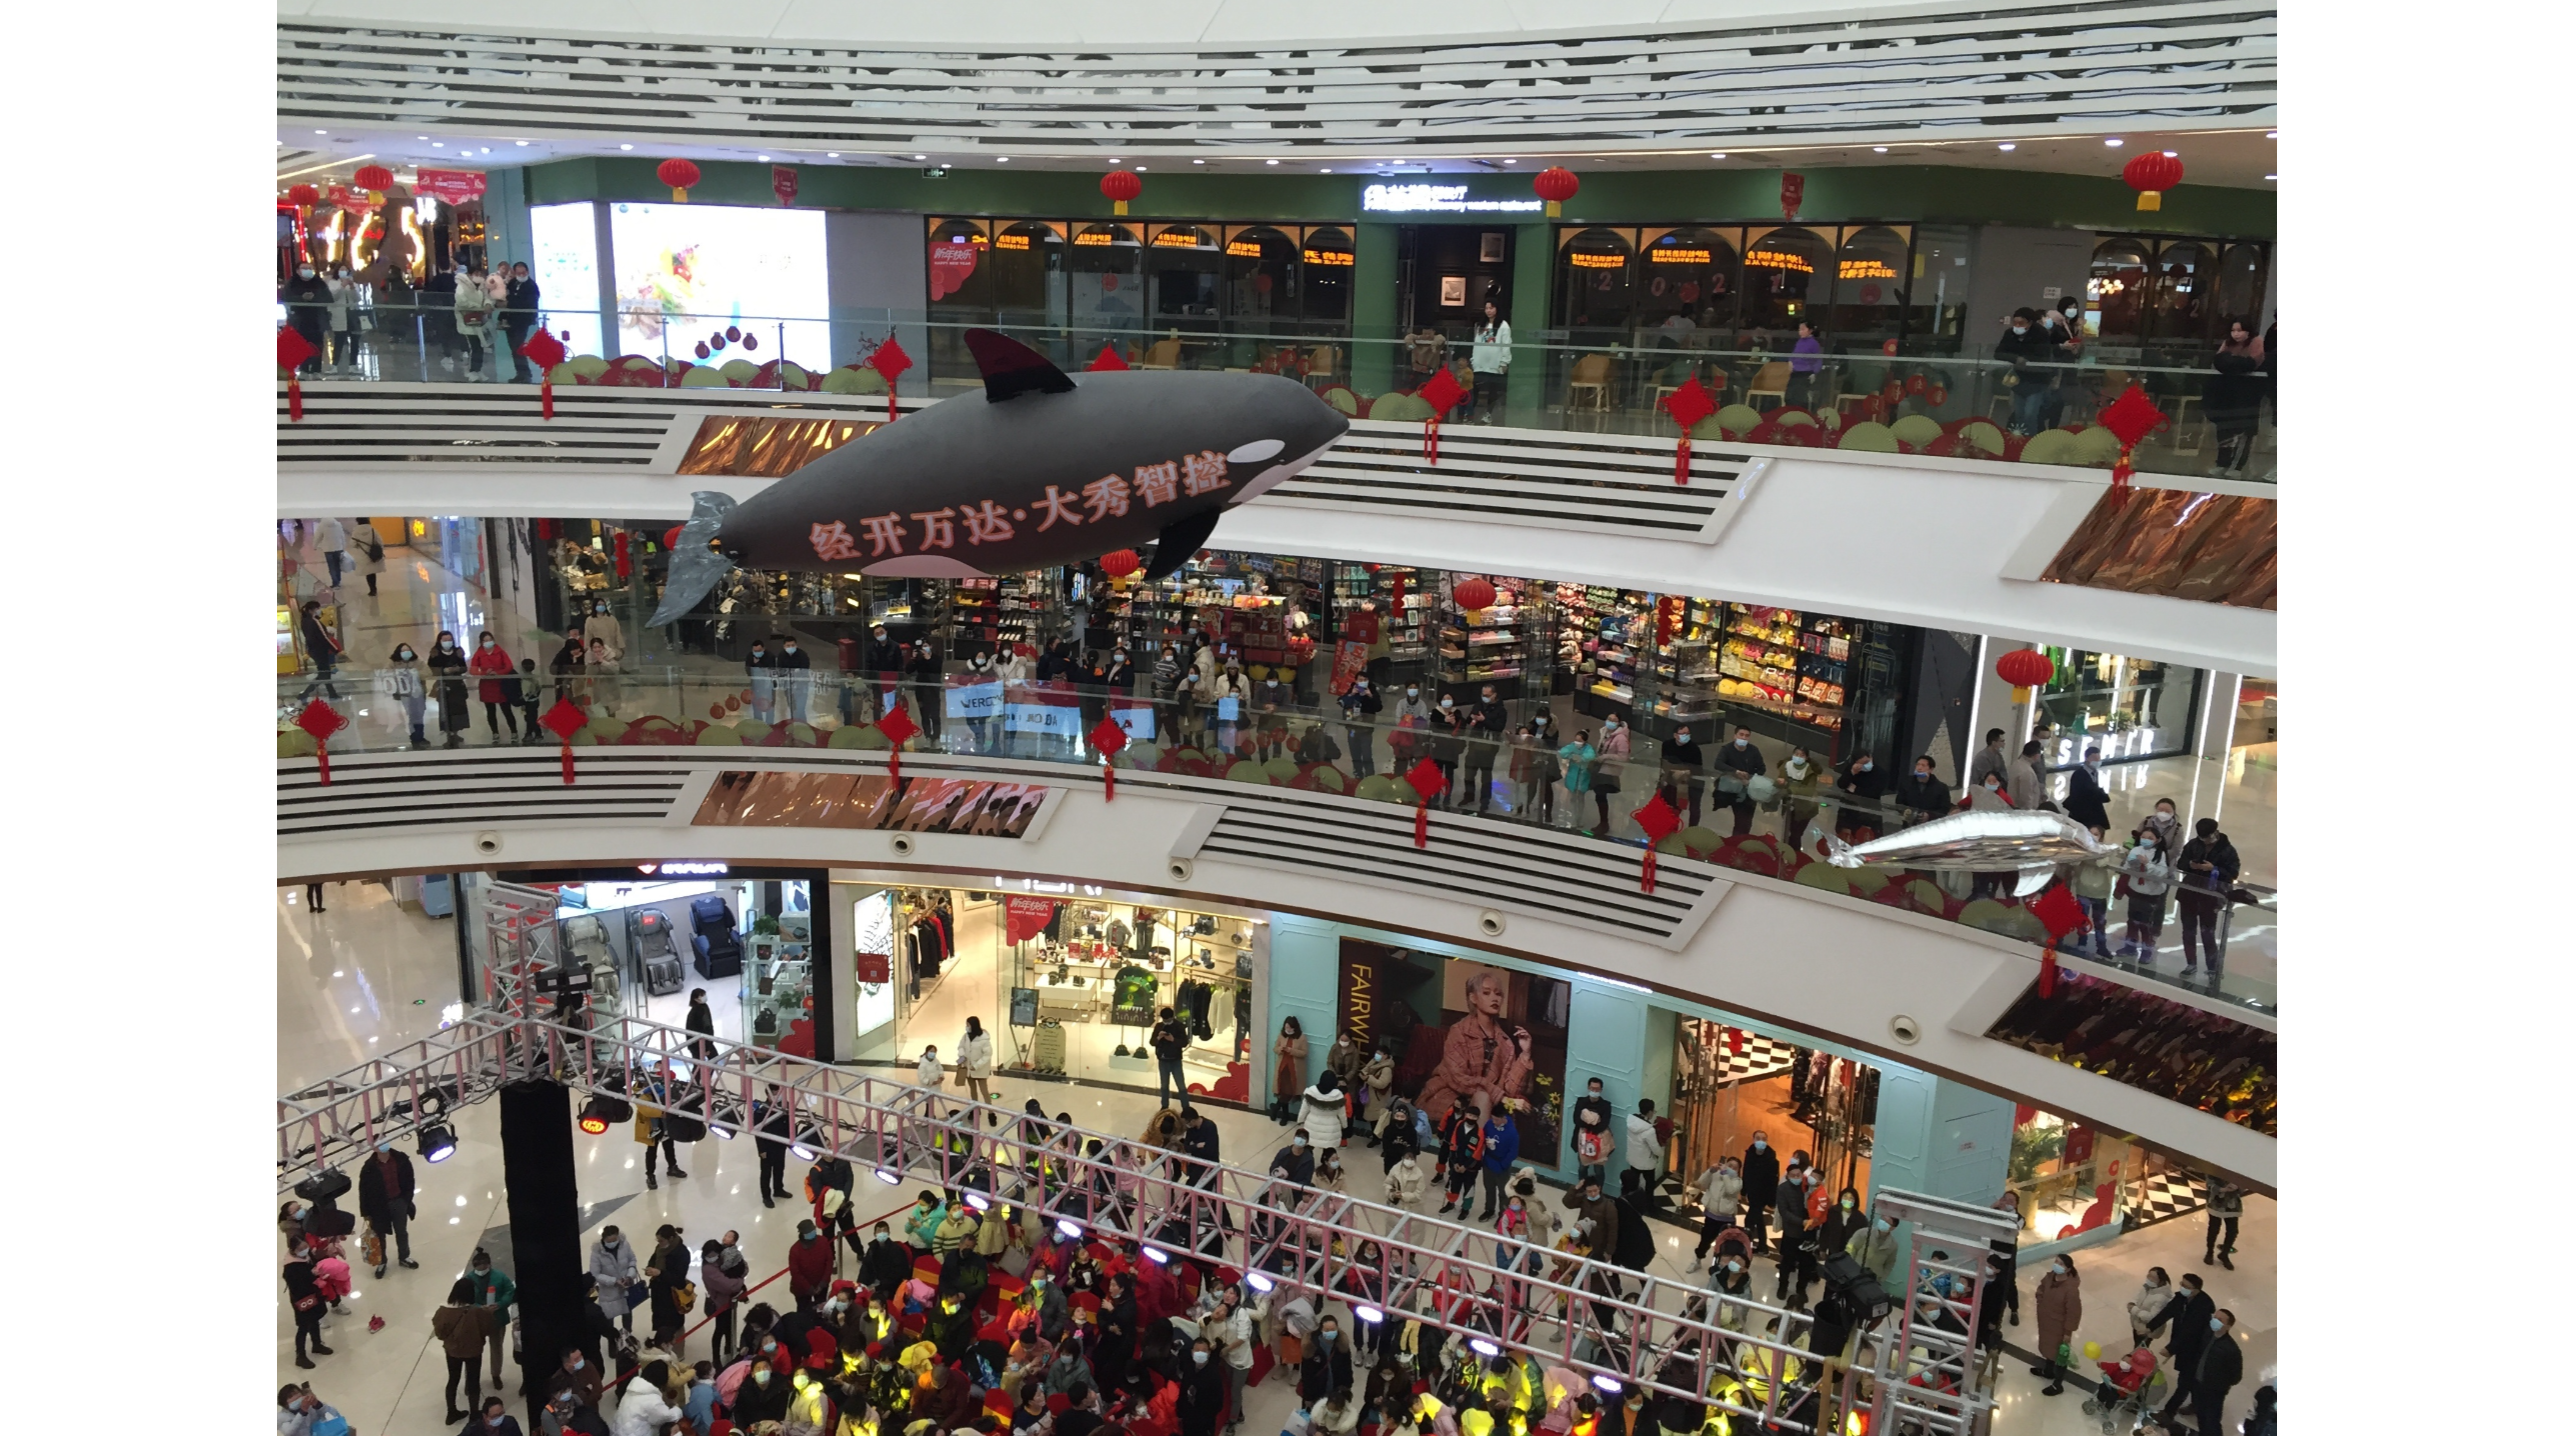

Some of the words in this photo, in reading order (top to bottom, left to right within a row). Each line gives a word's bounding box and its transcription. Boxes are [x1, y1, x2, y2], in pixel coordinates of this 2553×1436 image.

[933, 246, 973, 261] 新年快乐
[1598, 271, 1612, 291] 2
[1651, 276, 1666, 297] 0
[1712, 273, 1726, 293] 2
[809, 450, 1231, 562] 经开万达·大秀智控
[2058, 729, 2154, 765] SEMIR
[1010, 897, 1050, 911] 新年快乐
[1350, 963, 1372, 1068] FAIRWH
